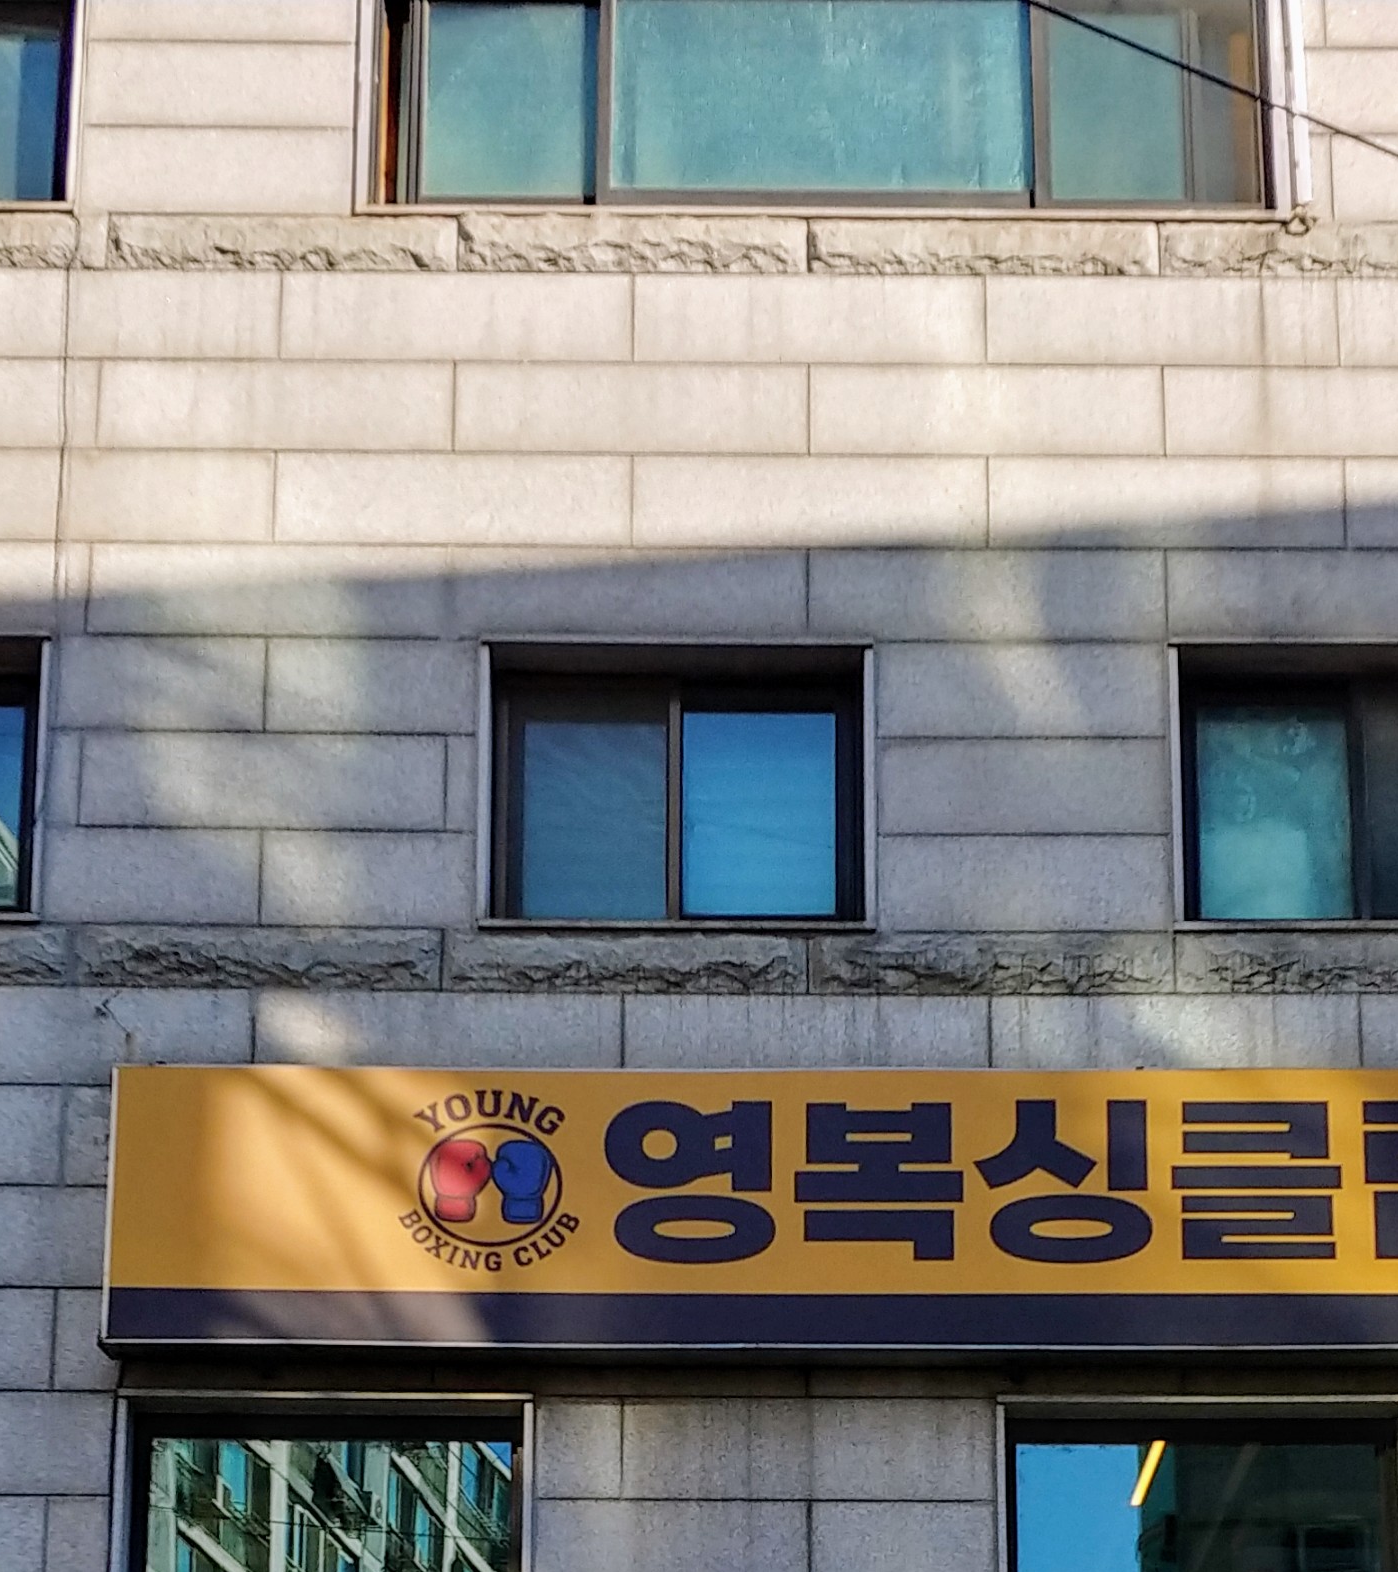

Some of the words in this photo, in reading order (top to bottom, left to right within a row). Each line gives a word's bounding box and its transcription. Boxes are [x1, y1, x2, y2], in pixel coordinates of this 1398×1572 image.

[413, 1090, 567, 1142] YOUNG
[397, 1206, 504, 1273] BOXING
[511, 1208, 582, 1268] CLUB
